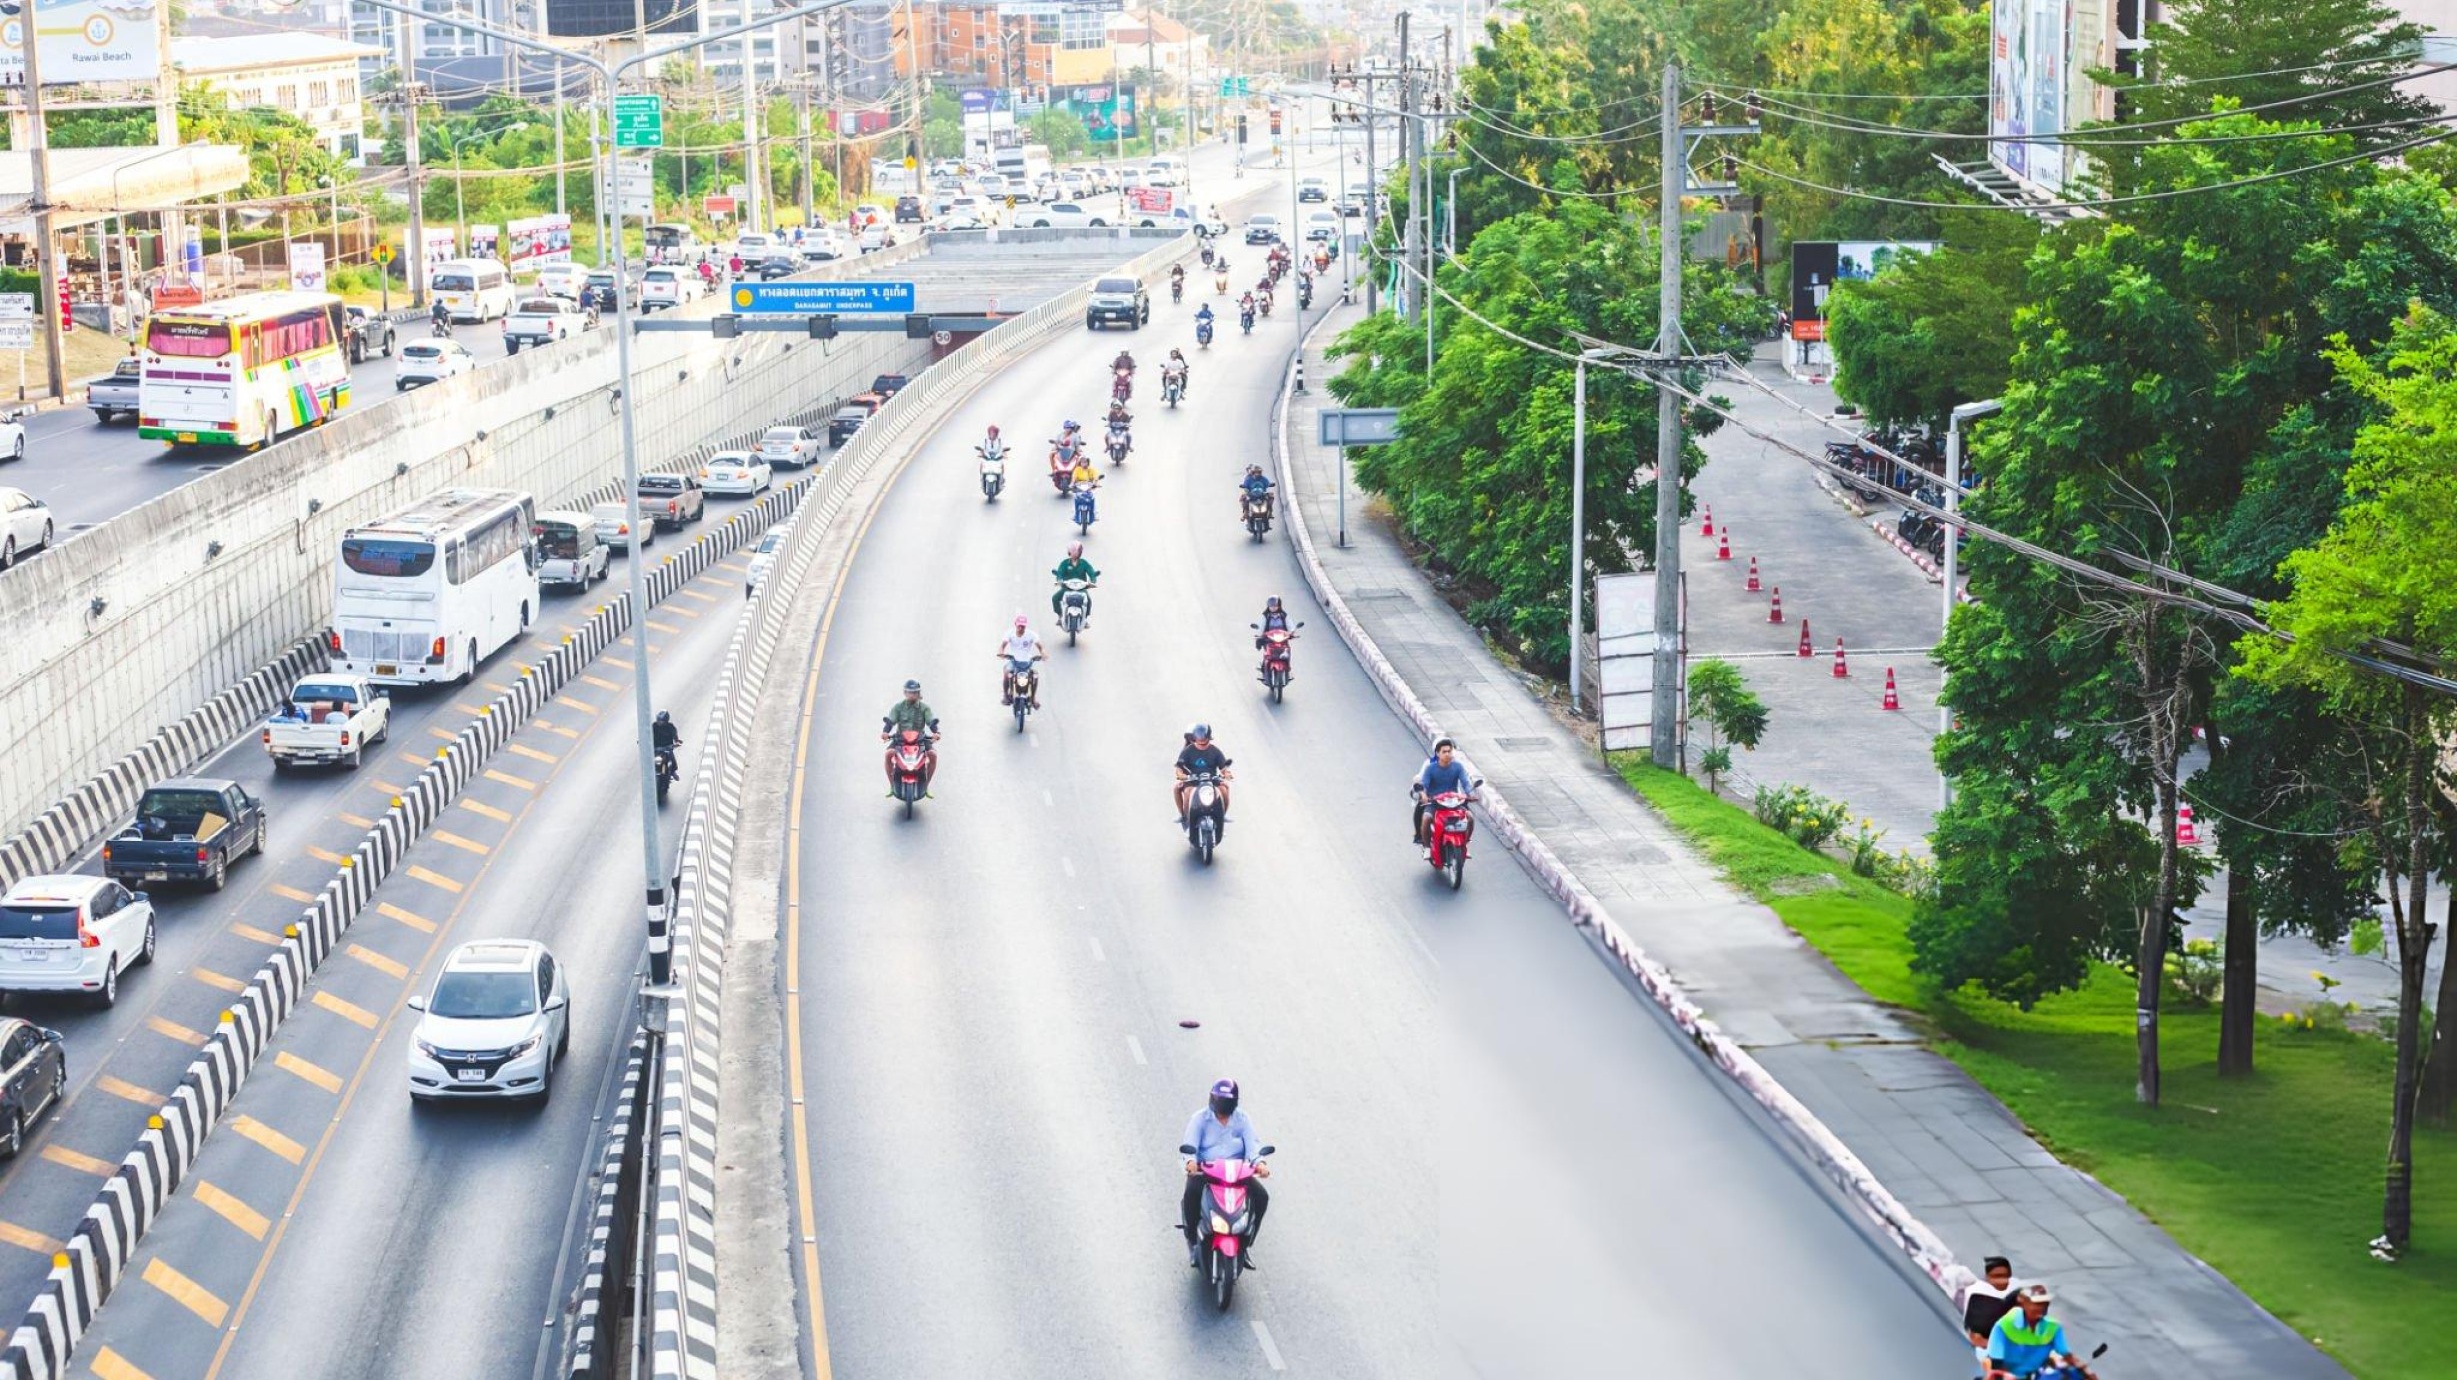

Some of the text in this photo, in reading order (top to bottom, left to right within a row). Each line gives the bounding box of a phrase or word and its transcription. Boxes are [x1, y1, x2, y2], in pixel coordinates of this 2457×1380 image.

[73, 51, 132, 62] Rawai Beach
[882, 284, 908, 301] ภูเก็ต
